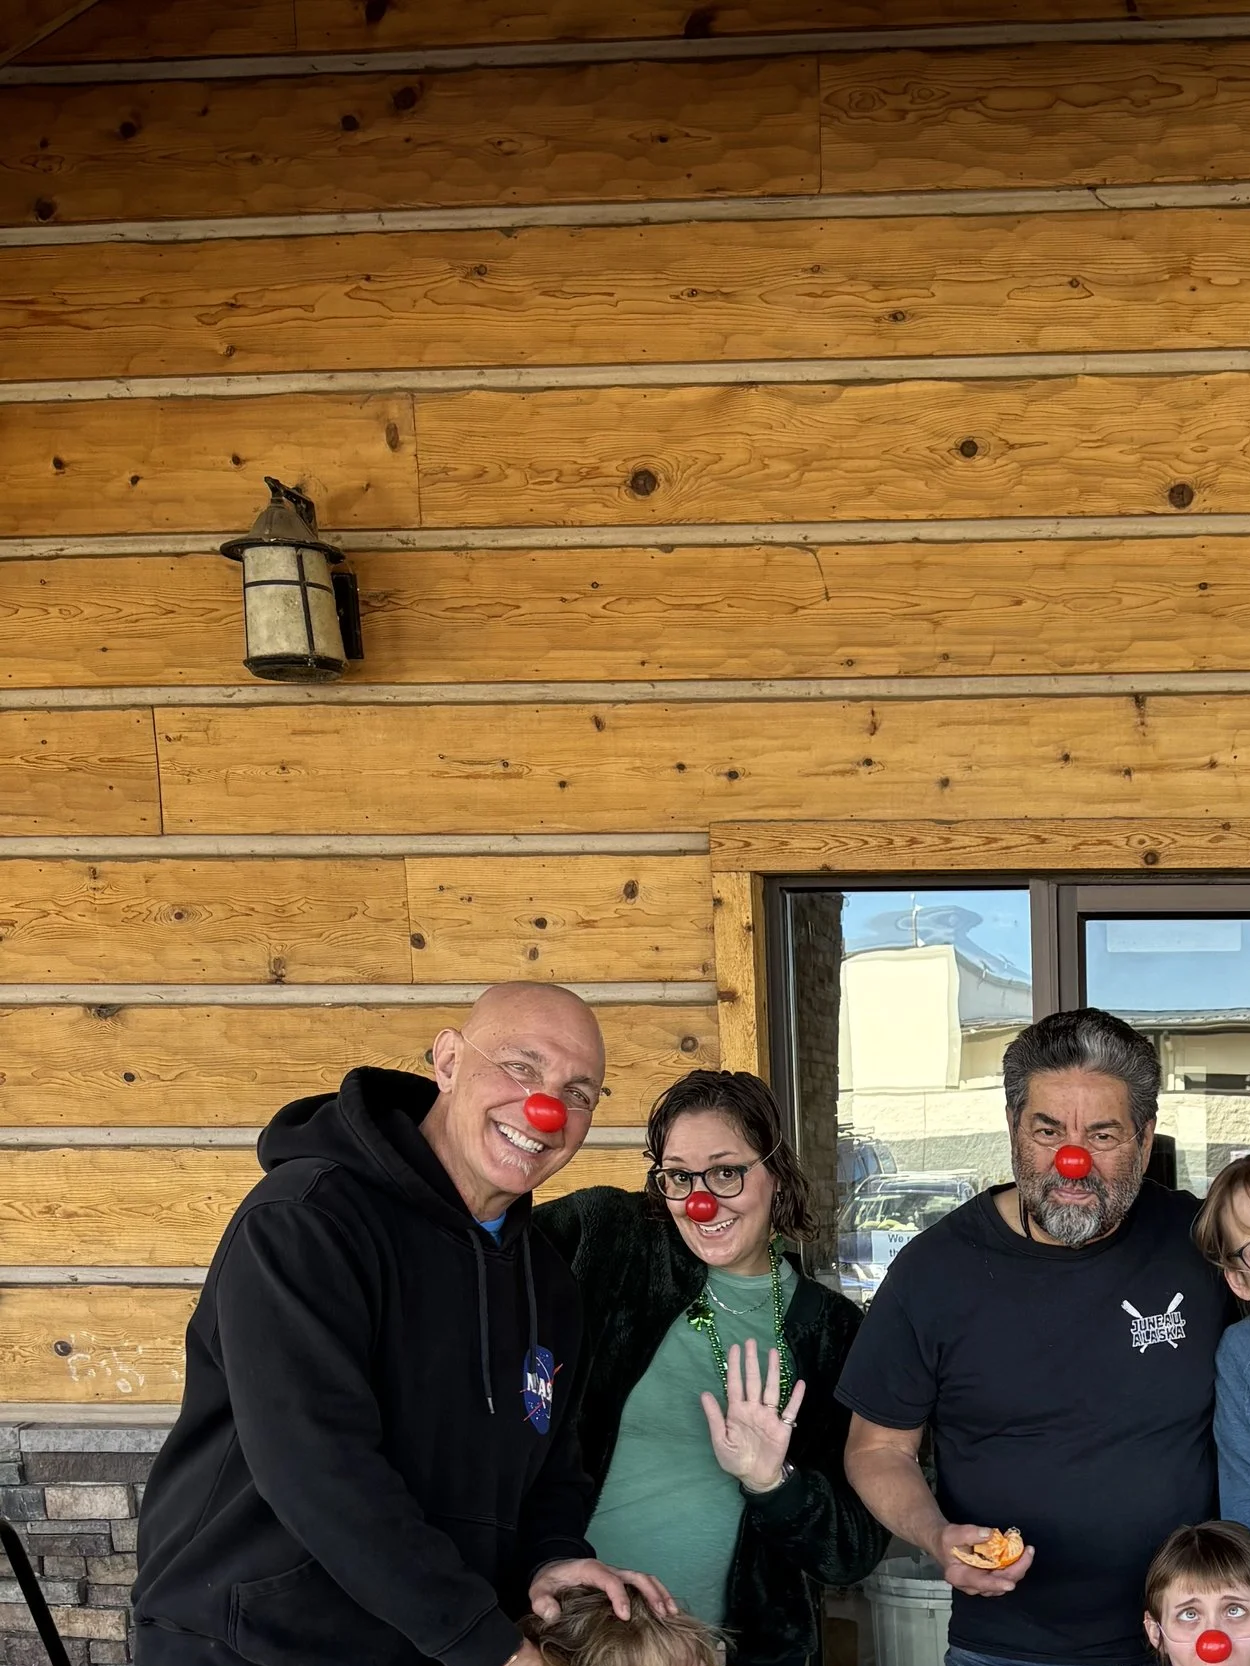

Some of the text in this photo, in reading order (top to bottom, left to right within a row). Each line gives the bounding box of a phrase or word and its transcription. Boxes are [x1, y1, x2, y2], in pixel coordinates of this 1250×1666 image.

[1130, 1311, 1187, 1334] JUNEAU,
[1132, 1325, 1186, 1348] ALASKA
[526, 1372, 553, 1403] NAS
